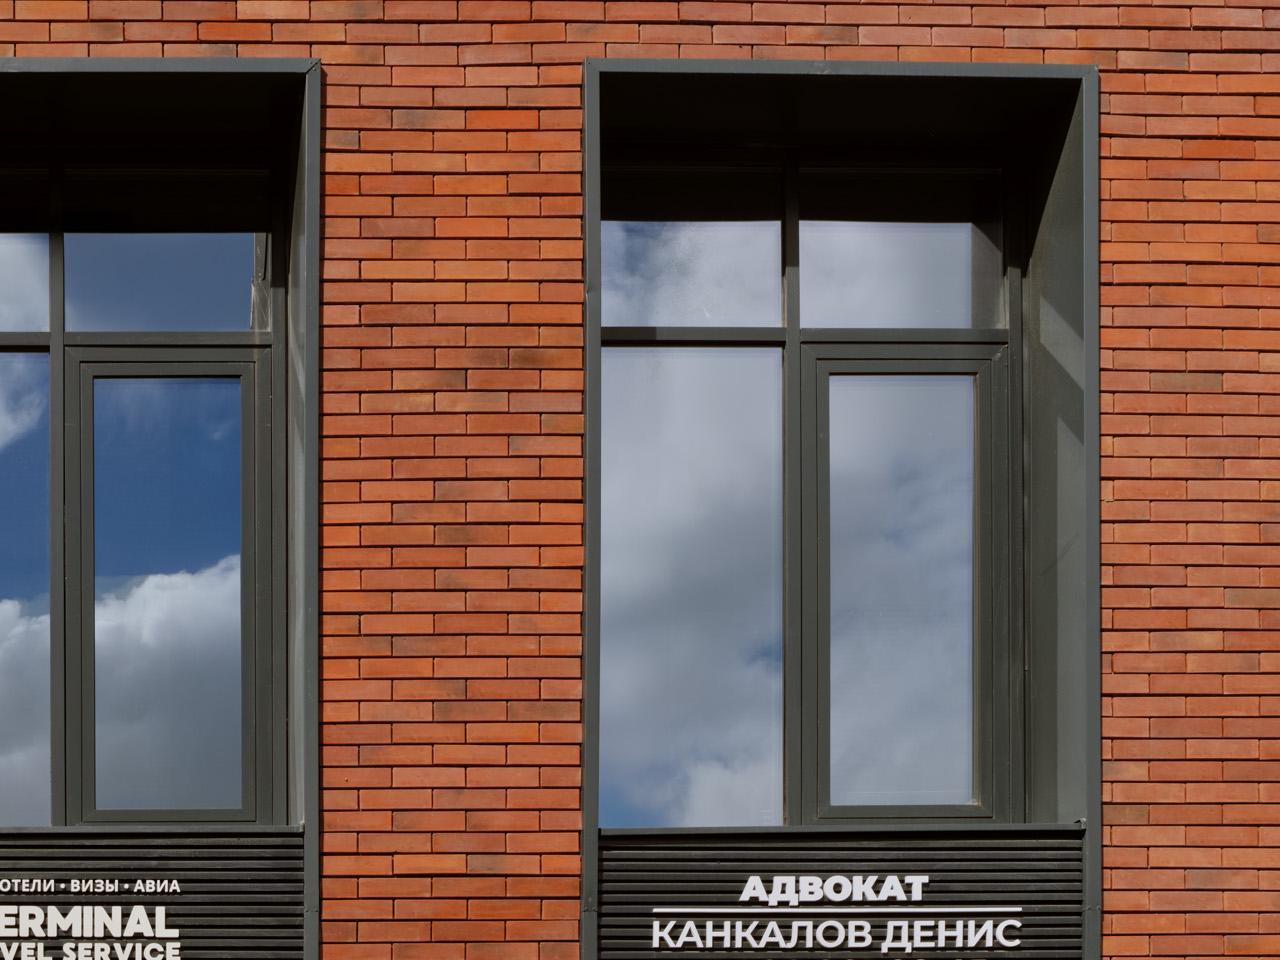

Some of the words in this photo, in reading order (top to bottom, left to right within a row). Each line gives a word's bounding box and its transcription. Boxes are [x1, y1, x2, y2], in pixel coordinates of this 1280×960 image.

[70, 879, 119, 893] ВИЗЫ
[133, 879, 181, 893] АВИА
[738, 875, 930, 907] АДВОКАТ
[652, 919, 873, 949] КАНКАЛОВ
[880, 919, 1023, 954] ДЕНИС
